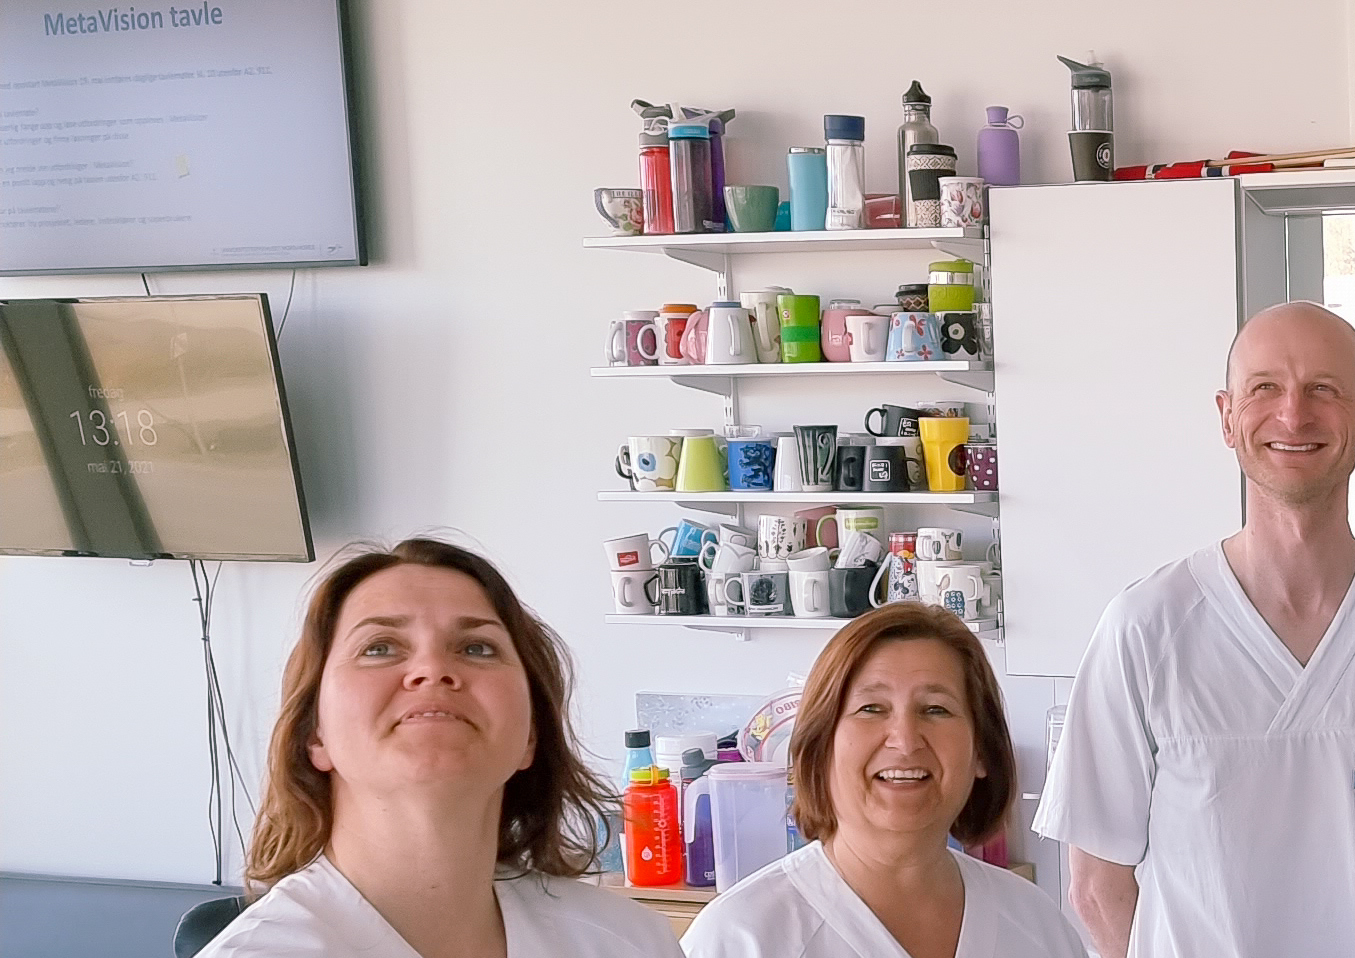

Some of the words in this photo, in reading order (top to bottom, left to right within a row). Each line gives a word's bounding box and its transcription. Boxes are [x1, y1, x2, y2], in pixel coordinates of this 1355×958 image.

[44, 7, 164, 36] MetaVision
[169, 1, 223, 28] tavle
[69, 409, 158, 446] 13:18
